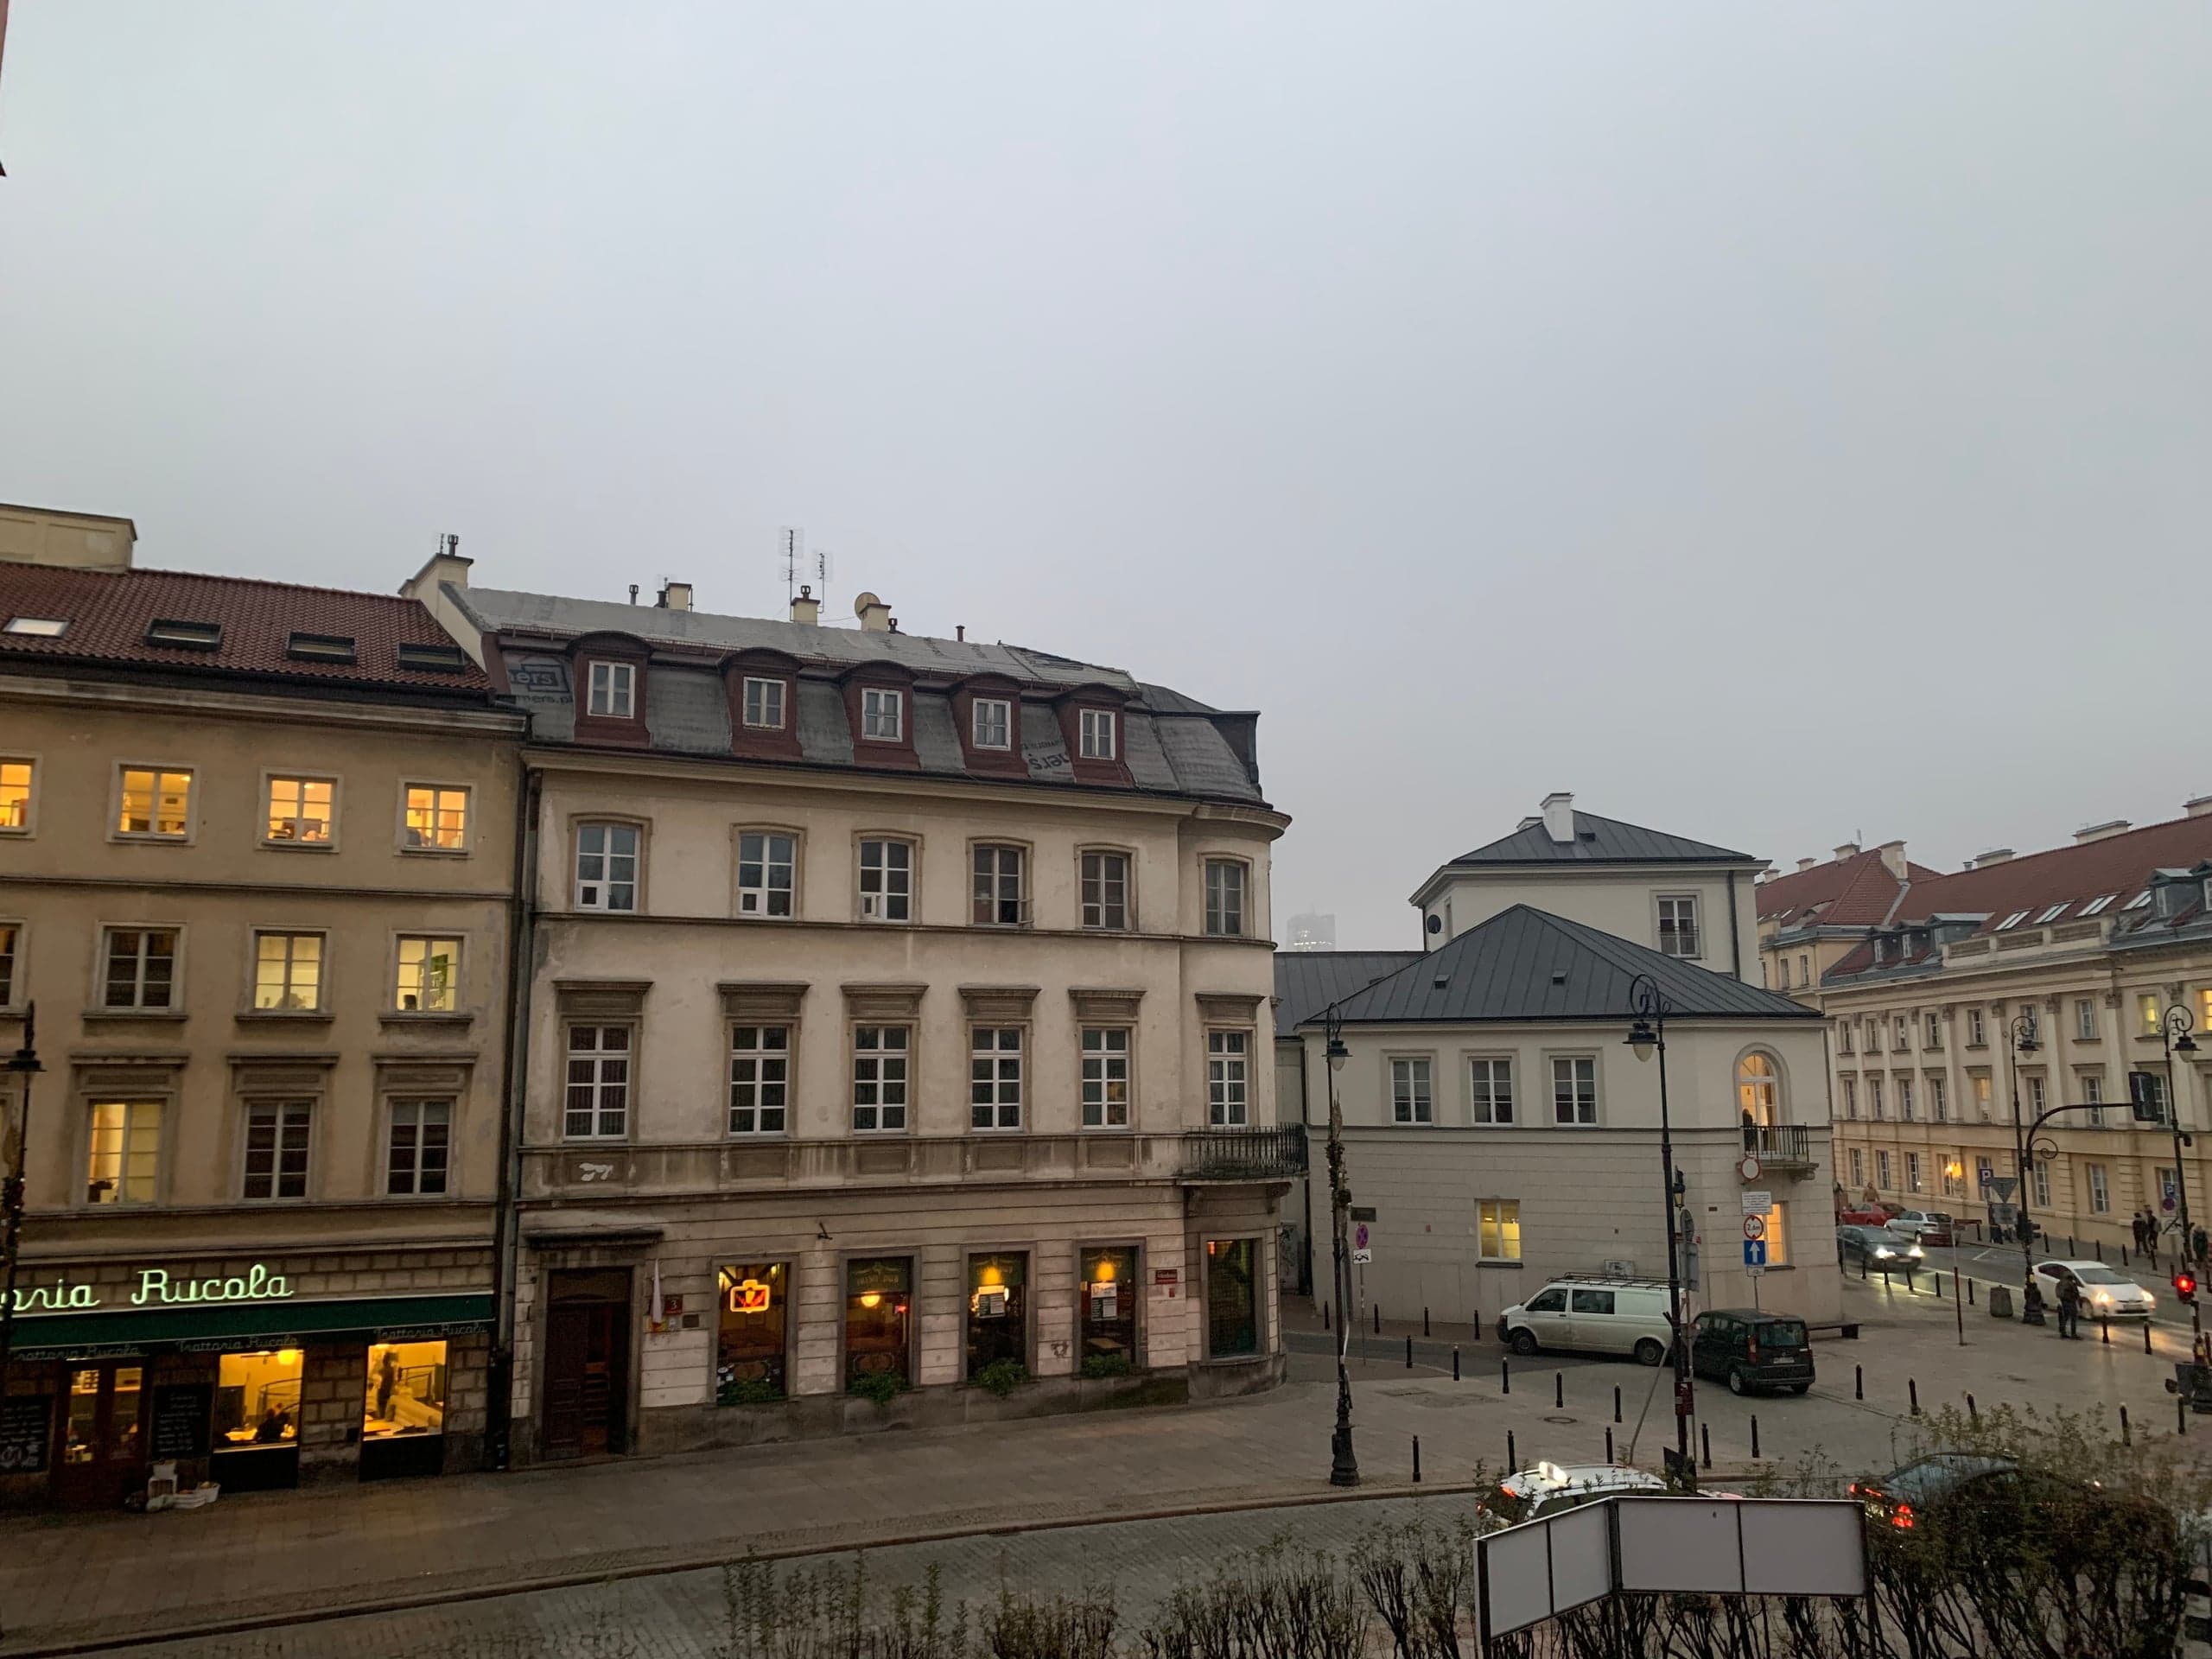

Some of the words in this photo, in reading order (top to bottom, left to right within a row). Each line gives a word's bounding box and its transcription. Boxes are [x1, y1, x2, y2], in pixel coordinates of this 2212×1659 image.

[1981, 1170, 1991, 1182] P
[131, 1263, 294, 1305] Rucola
[175, 1339, 243, 1352] Trattoria
[247, 1334, 299, 1348] Rucola
